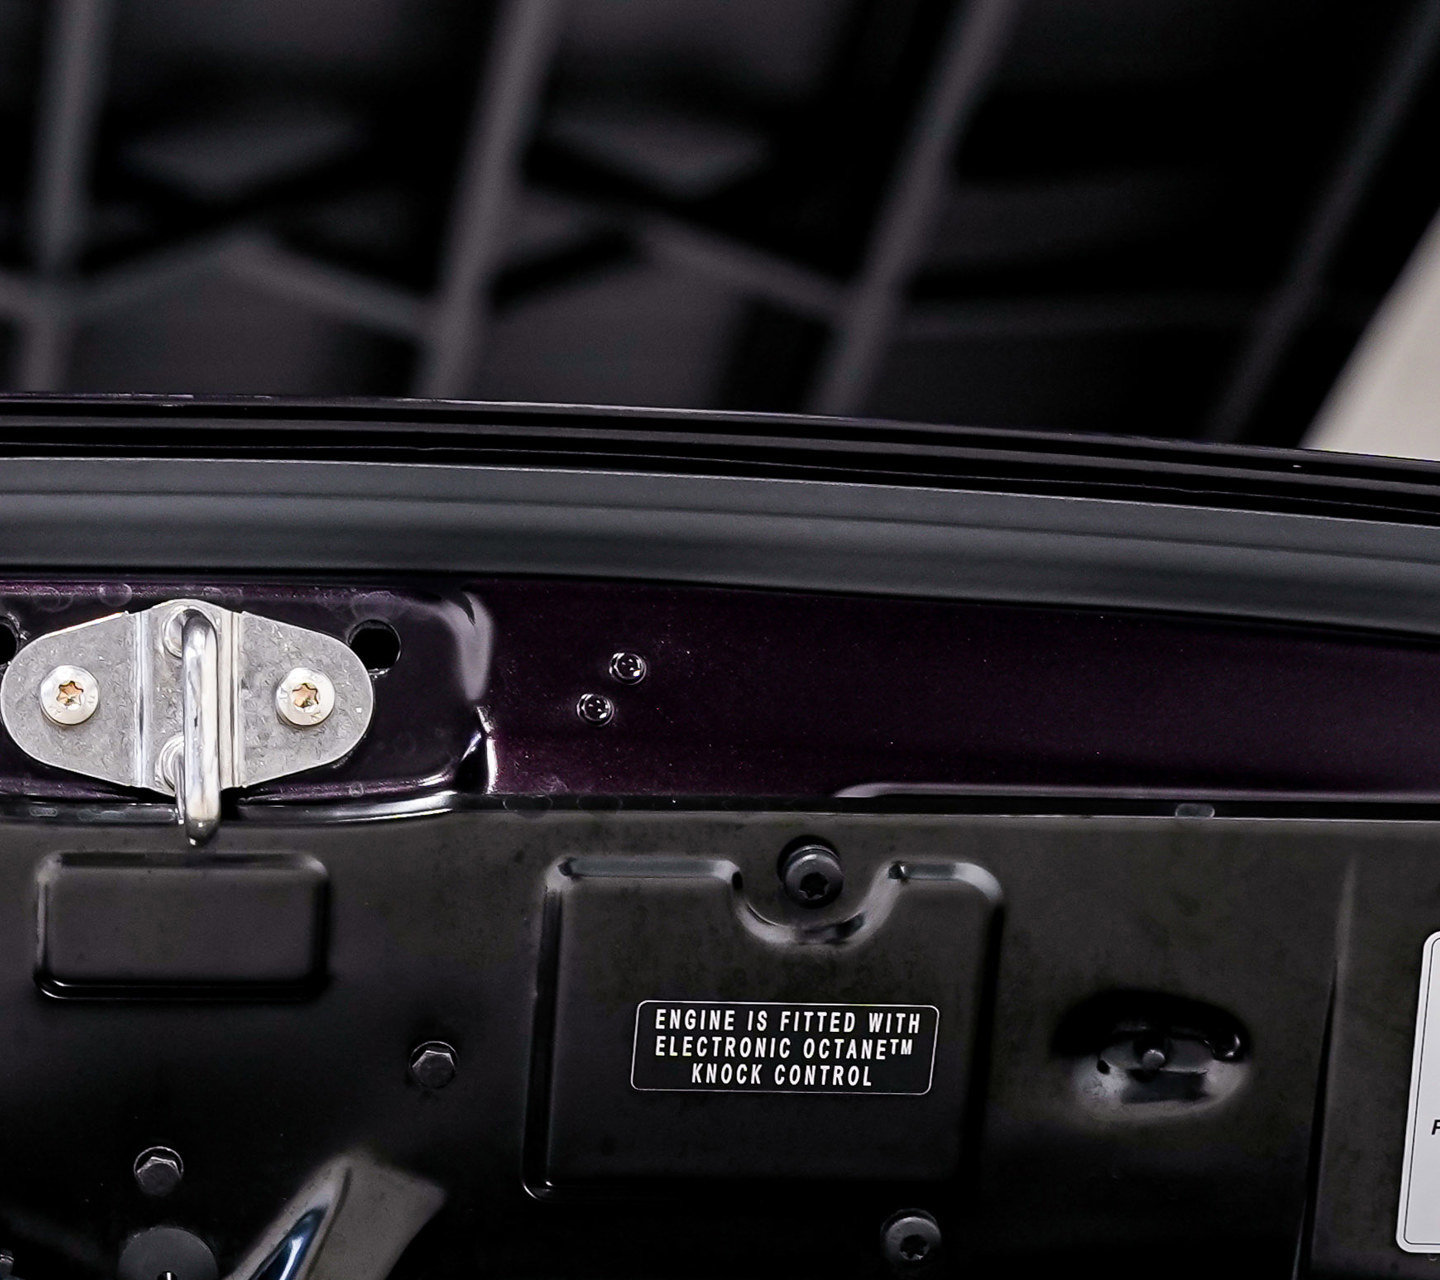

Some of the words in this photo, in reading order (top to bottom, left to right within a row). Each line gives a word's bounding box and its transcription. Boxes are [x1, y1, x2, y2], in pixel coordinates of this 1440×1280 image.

[656, 1009, 735, 1030] ENGINE
[748, 1011, 767, 1031] IS
[780, 1011, 855, 1032] FITTED
[869, 1013, 920, 1033] WITH
[656, 1036, 790, 1058] ELECTRONIC
[692, 1063, 762, 1084] KNOCK
[775, 1065, 871, 1086] CONTROL
